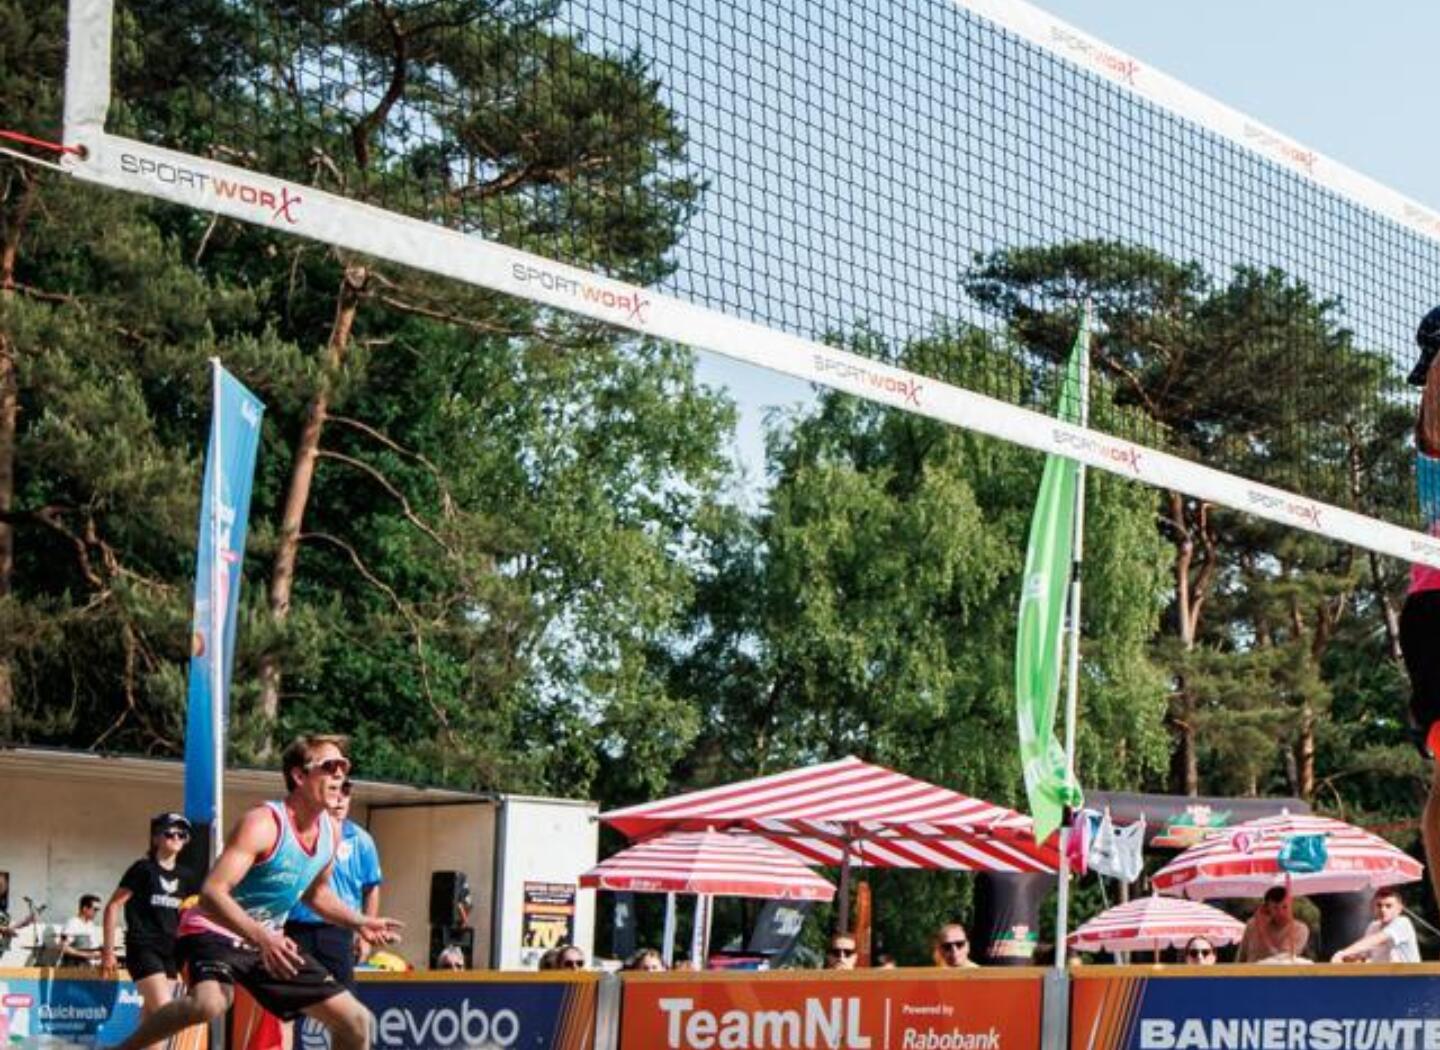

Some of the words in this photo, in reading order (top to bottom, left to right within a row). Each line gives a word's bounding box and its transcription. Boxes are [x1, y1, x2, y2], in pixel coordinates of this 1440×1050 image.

[119, 153, 302, 224] SPORTWORX
[512, 263, 651, 324] SPORTWORX
[658, 998, 872, 1049] TeamNL
[902, 1004, 941, 1014] Powered
[942, 1004, 954, 1017] by
[902, 1027, 1000, 1050] Rabobank
